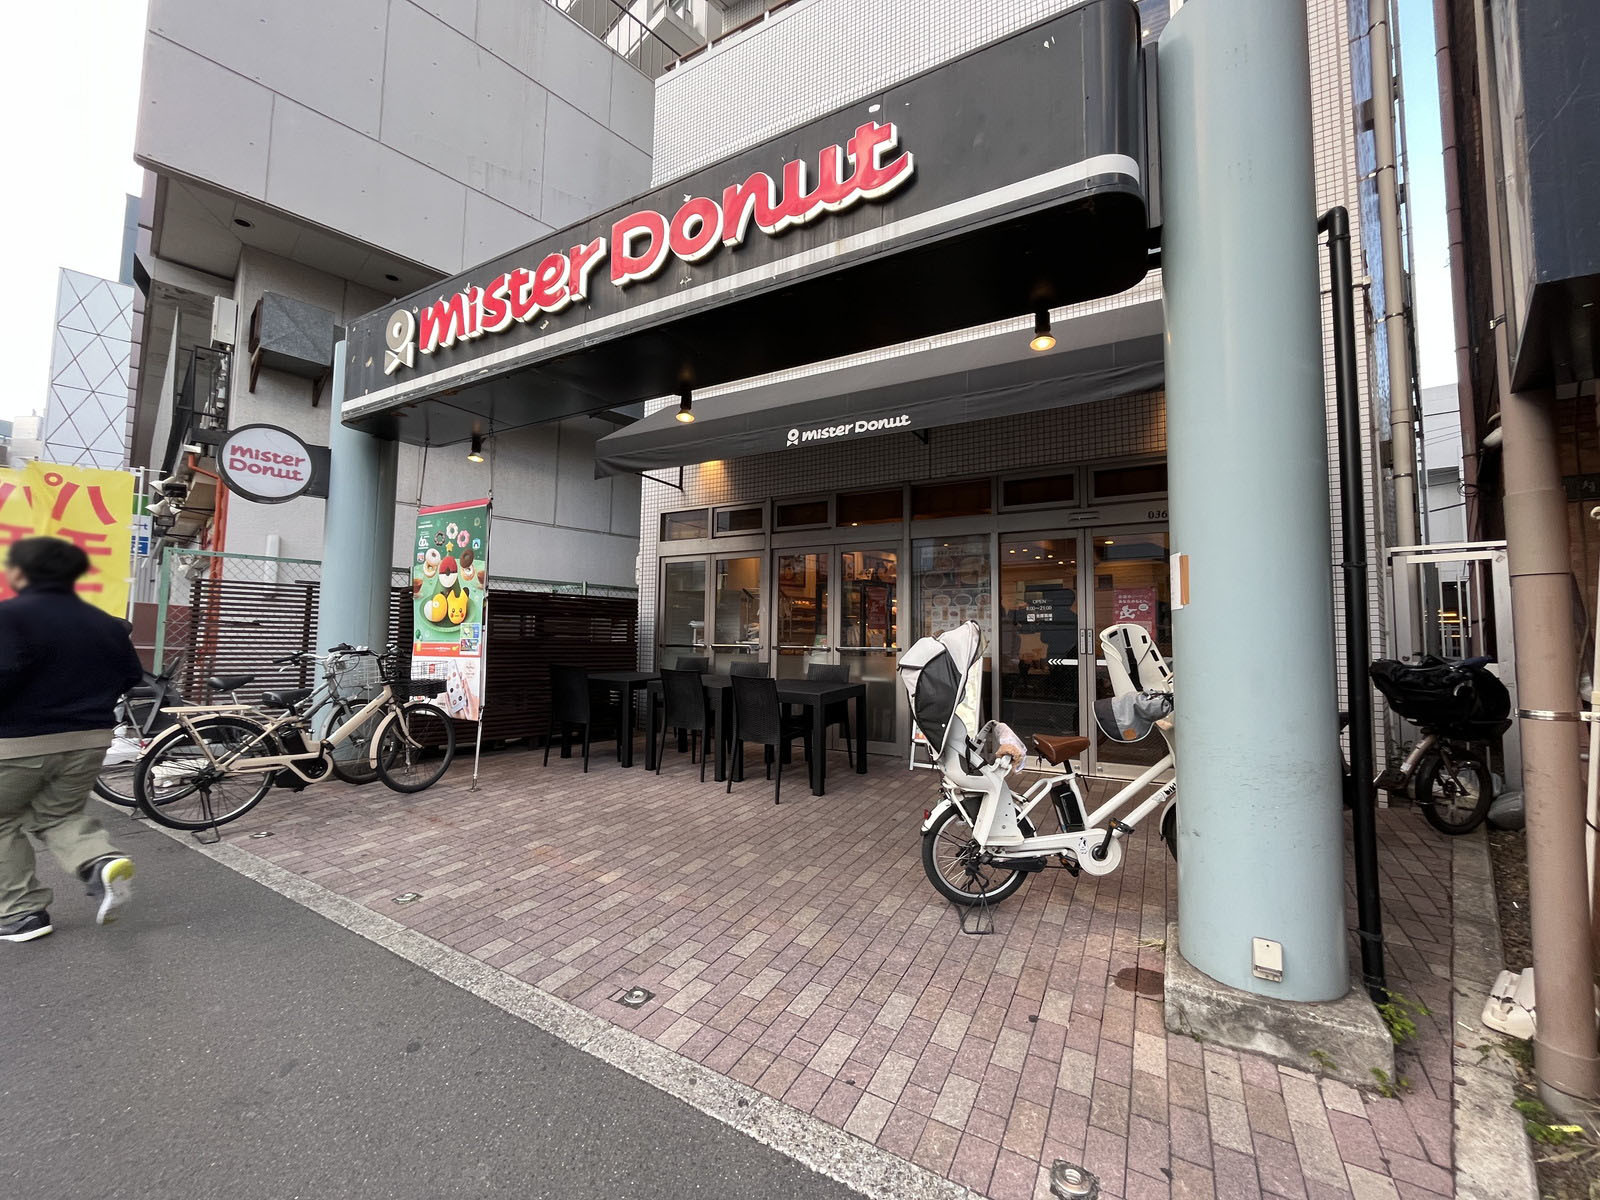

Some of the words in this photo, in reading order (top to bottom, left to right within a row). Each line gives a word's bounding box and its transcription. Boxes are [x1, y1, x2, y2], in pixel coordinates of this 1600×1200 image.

[610, 120, 913, 287] Donut
[854, 414, 912, 433] Donut
[228, 457, 305, 482] Donut
